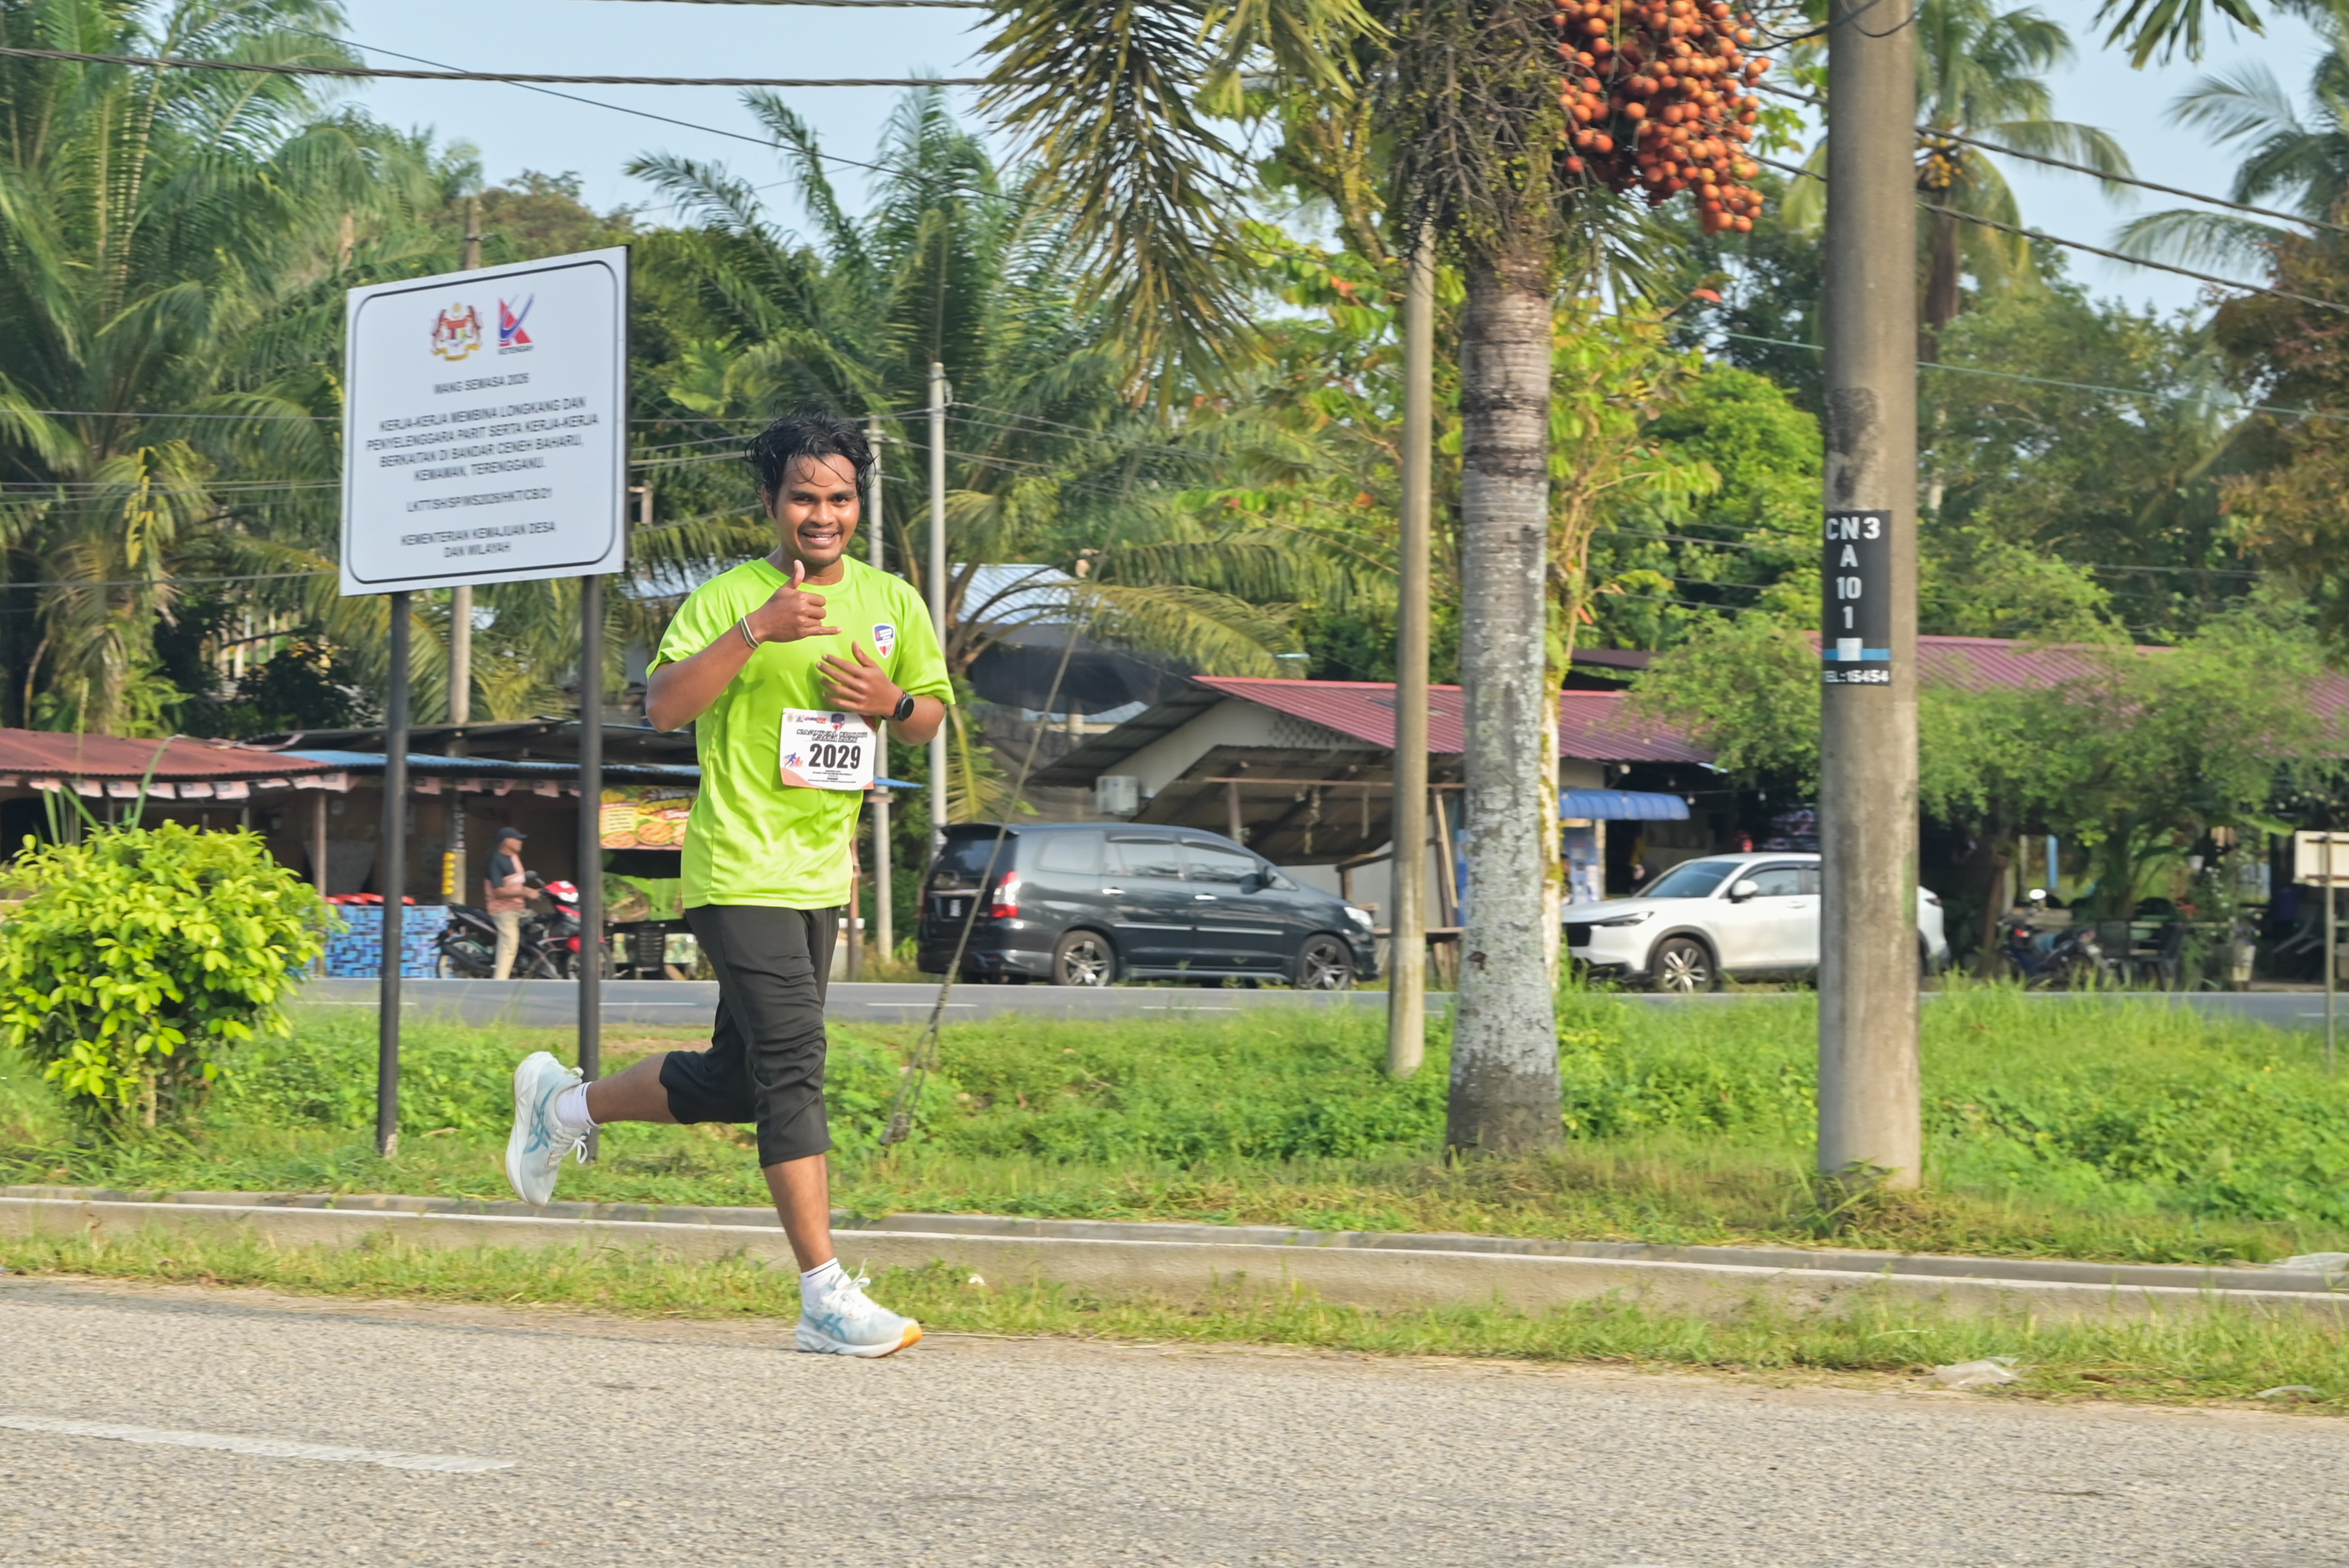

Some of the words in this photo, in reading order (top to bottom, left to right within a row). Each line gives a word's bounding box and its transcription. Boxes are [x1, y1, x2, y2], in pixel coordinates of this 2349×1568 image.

[434, 382, 463, 394] WANG
[464, 377, 506, 390] SEMASA
[380, 414, 449, 431] KERJA-KERJA
[450, 408, 498, 423] MEMBINA
[500, 400, 560, 418] LONGKANG
[563, 397, 586, 410] DAN
[367, 431, 455, 451] PENYELENGGARA
[457, 426, 487, 439] PARIT
[489, 423, 523, 437] SERTA
[525, 414, 599, 432] KERJA-KERJA
[380, 451, 436, 467] BERKAITAN
[439, 450, 449, 461] DI
[451, 444, 495, 459] BANDAR
[497, 440, 533, 454] CENEH
[401, 530, 469, 546] KEMENTERIAN
[472, 525, 526, 539] KEMAJUAN
[529, 522, 556, 534] DESA
[444, 546, 465, 557] DAN
[467, 542, 510, 555] WILAYAH
[1840, 544, 1859, 567] A
[1836, 577, 1862, 599] 10
[1842, 606, 1854, 628] 1
[809, 743, 861, 769] 2029
